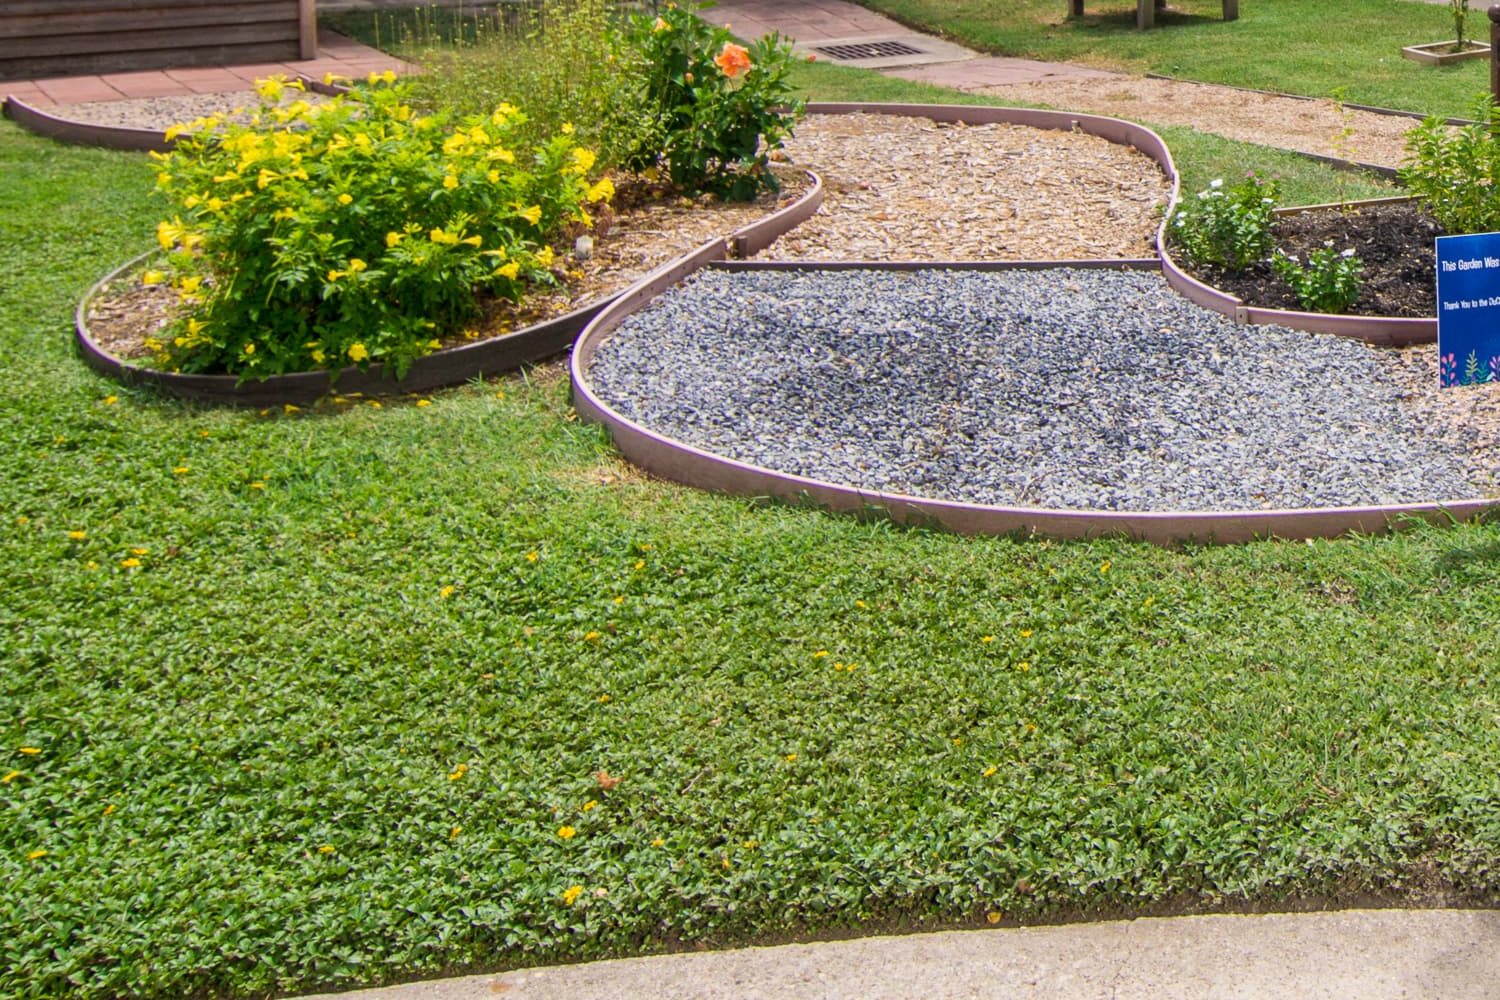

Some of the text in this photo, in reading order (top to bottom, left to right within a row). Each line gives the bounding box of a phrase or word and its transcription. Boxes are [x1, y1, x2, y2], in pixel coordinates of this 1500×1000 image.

[1442, 261, 1457, 272] This
[1458, 258, 1482, 270] Garden
[1484, 256, 1500, 268] Was
[1444, 301, 1460, 310] Thank
[1460, 300, 1471, 309] You
[1472, 299, 1478, 308] to
[1479, 298, 1488, 307] the
